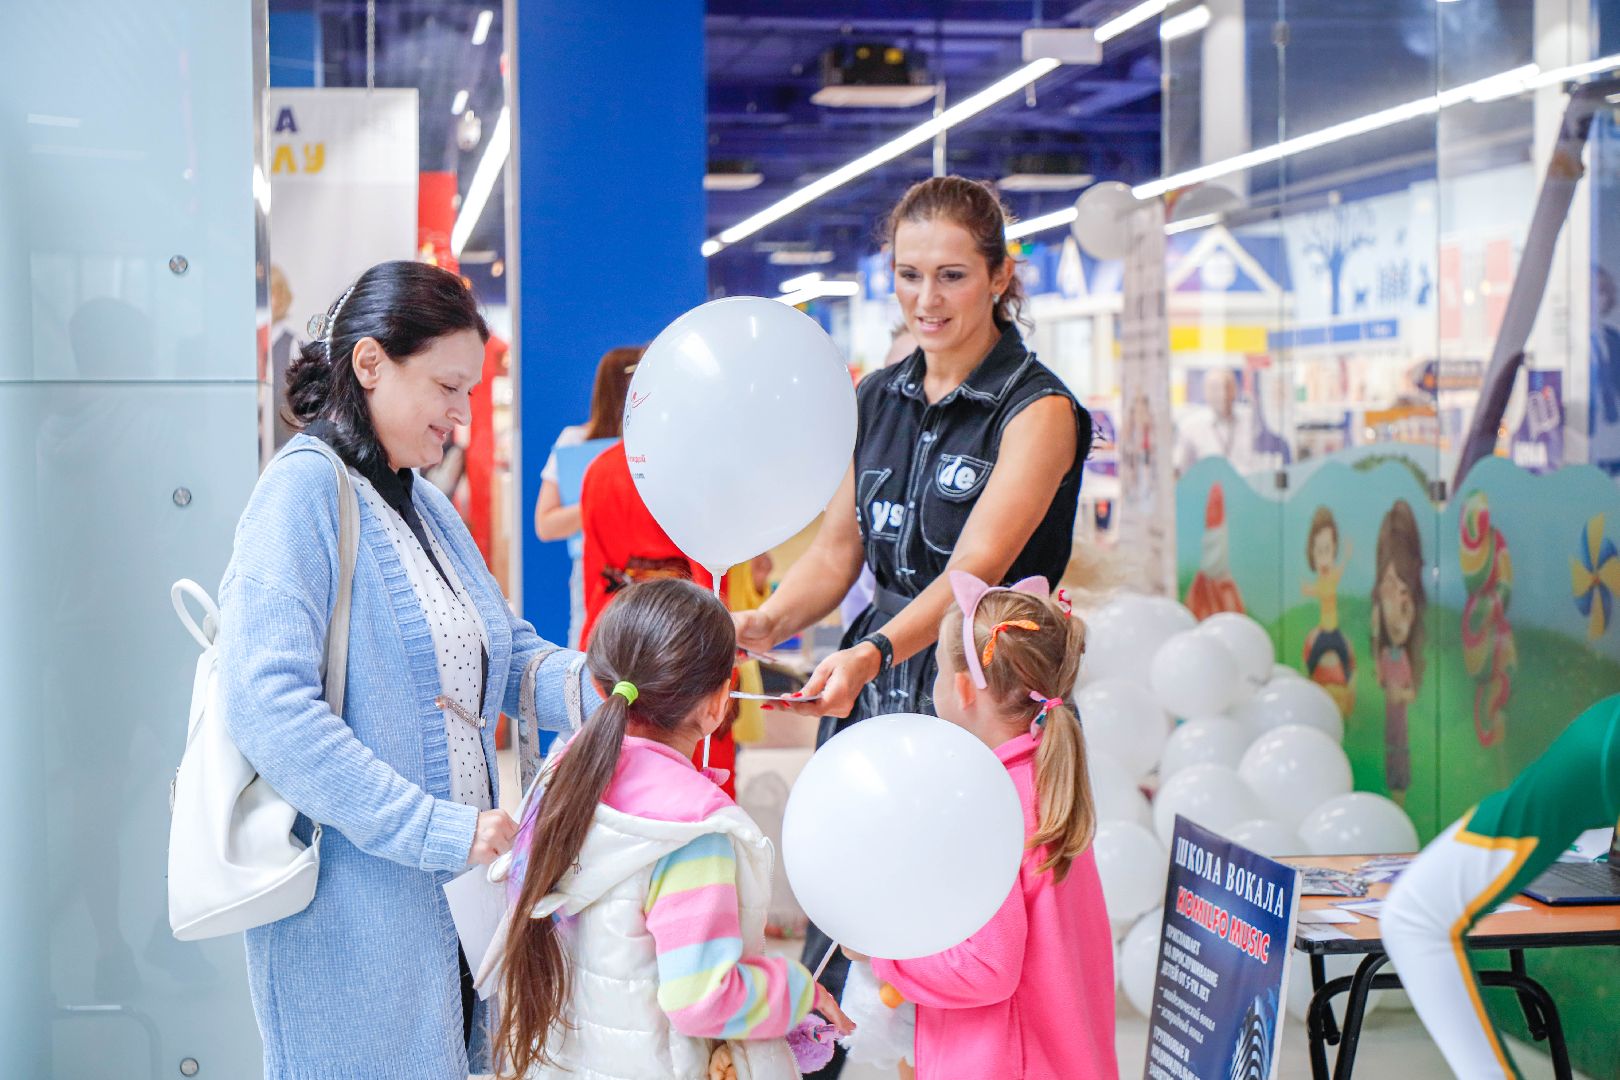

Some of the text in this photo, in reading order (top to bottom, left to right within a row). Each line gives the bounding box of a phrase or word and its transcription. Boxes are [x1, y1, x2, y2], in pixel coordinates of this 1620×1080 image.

[1175, 836, 1285, 919] ШКОЛА ВОКАЛА
[1228, 915, 1271, 965] MUSIC
